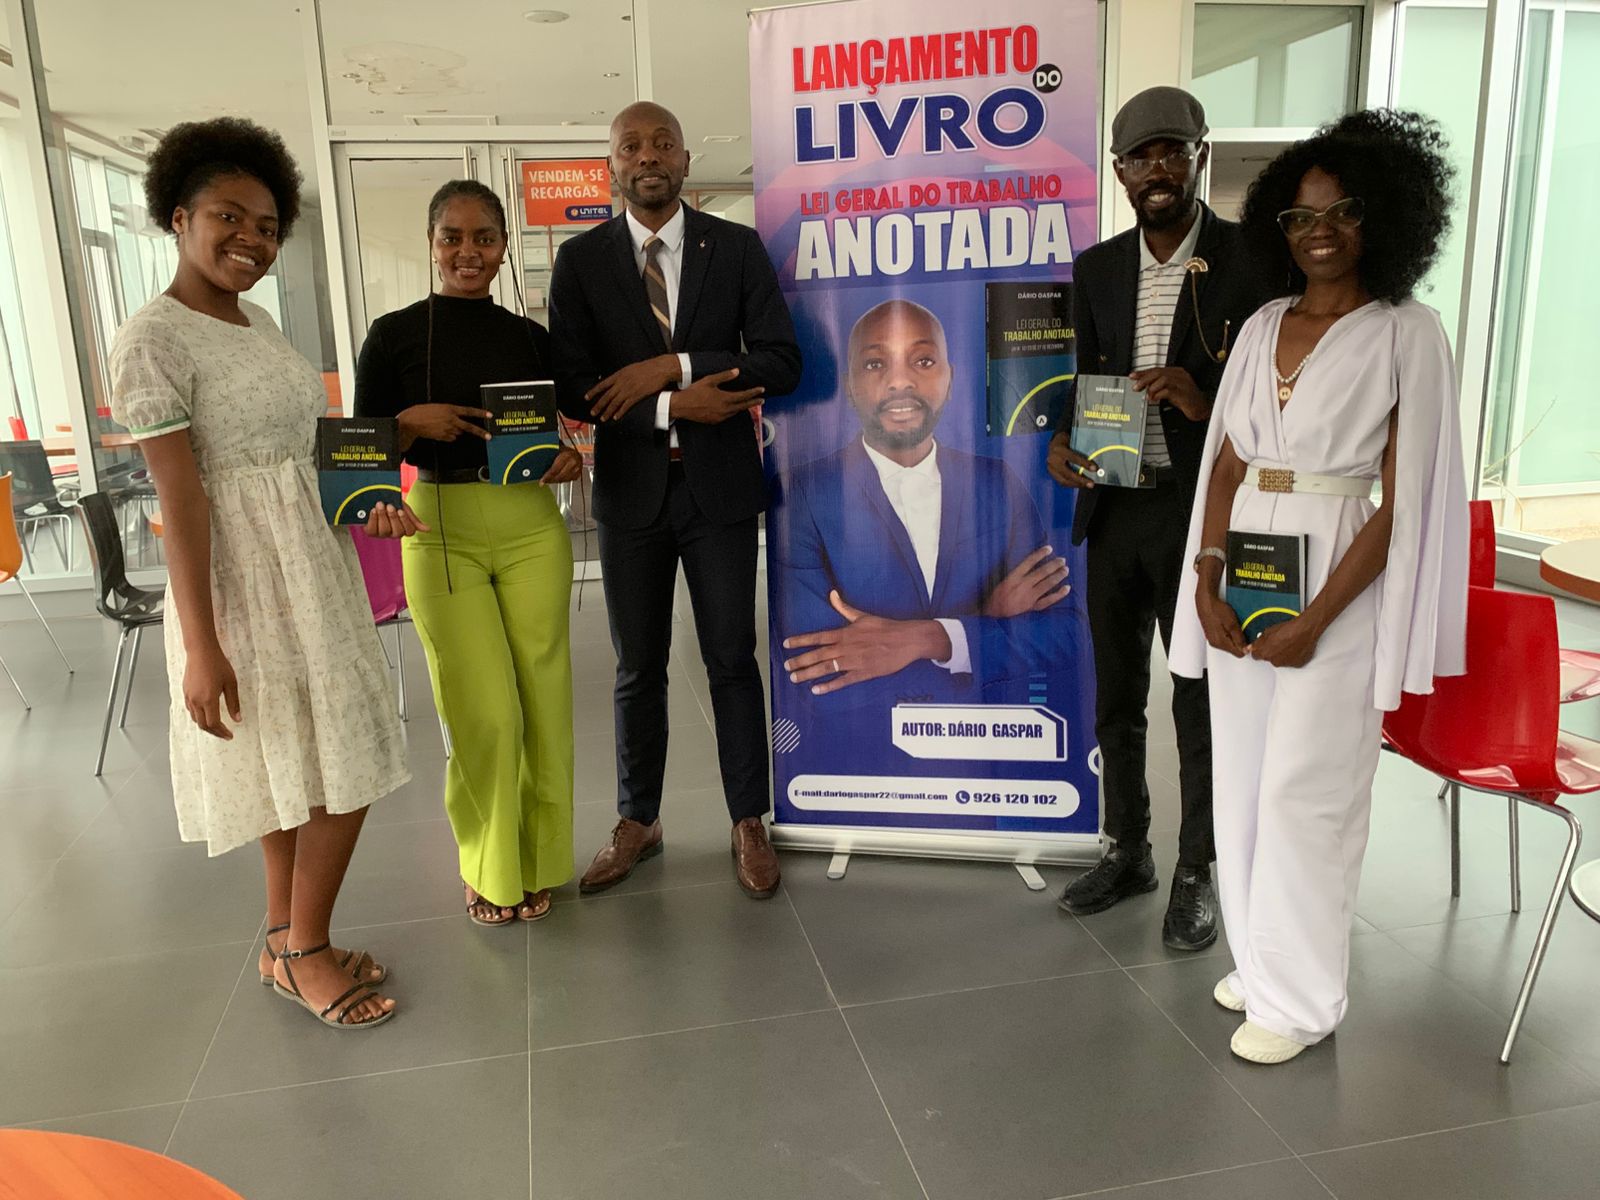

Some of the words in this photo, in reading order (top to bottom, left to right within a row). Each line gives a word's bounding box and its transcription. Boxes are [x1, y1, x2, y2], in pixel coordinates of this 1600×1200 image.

[792, 24, 1038, 94] LANÇAMENTO
[1036, 70, 1060, 87] DO
[795, 86, 1046, 163] LIVRO
[528, 168, 604, 183] VENDEM-SE
[530, 185, 599, 200] RECARGAS
[801, 192, 830, 216] LEI
[836, 186, 904, 214] GERAL
[910, 183, 941, 208] DO
[947, 174, 1062, 204] TRABALHO
[795, 202, 1073, 281] ANOTADA
[1016, 319, 1027, 330] LEI
[1028, 318, 1050, 330] GERAL
[1052, 318, 1062, 328] DO
[1004, 330, 1042, 342] TRABALHO
[1043, 328, 1076, 339] ANOTADA
[496, 418, 522, 426] TRABALHO
[523, 416, 545, 424] ANOTADA
[1235, 569, 1260, 579] TRABALHO
[1261, 572, 1285, 582] ANOTADA
[902, 722, 946, 737] AUTOR:
[948, 720, 986, 737] DÁRIO
[992, 723, 1043, 738] GASPAR
[973, 792, 1001, 803] 926
[1004, 794, 1029, 804] 120
[1032, 794, 1057, 805] 102
